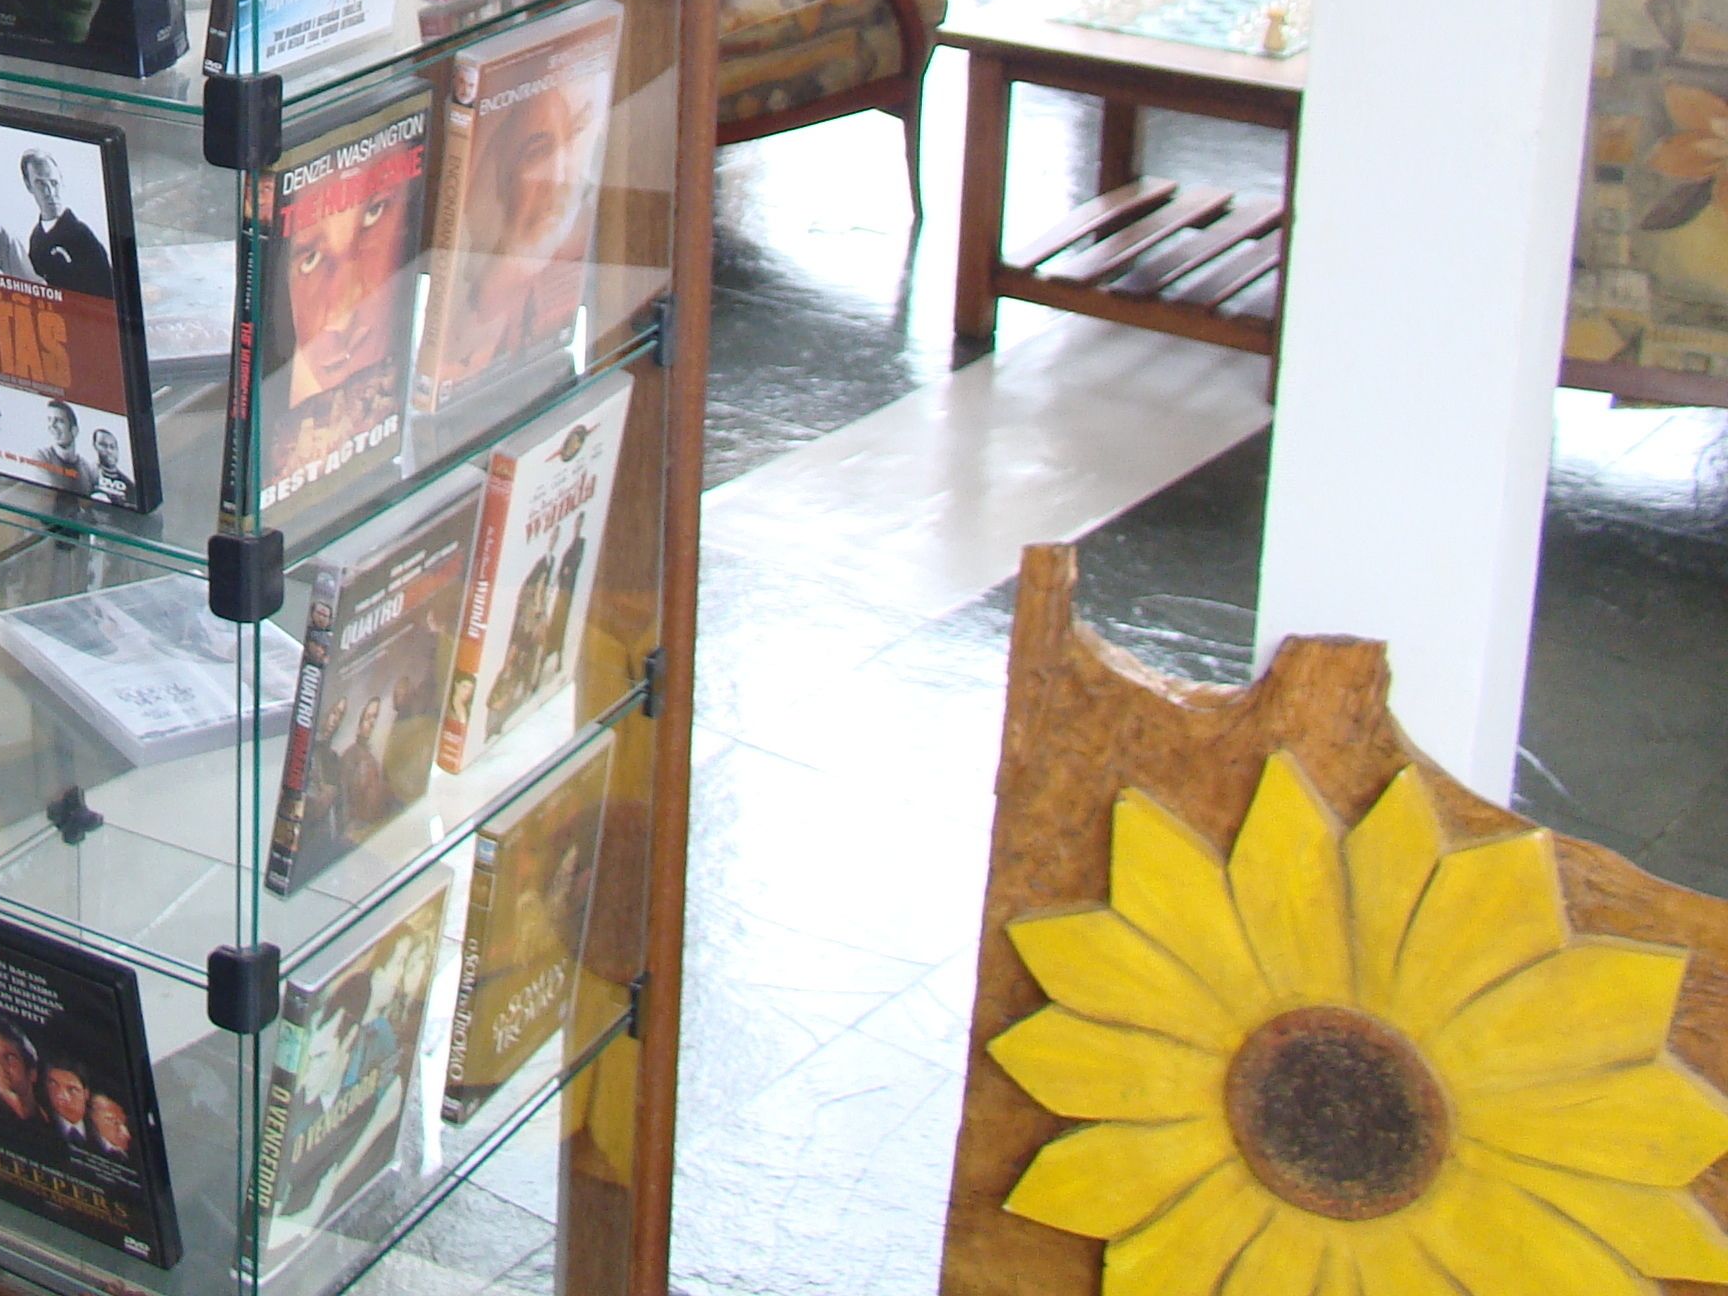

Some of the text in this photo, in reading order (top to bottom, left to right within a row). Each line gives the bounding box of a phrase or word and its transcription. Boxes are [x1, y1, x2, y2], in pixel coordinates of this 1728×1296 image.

[204, 60, 223, 72] DVD
[283, 113, 425, 196] DENZEL WASHINGTON
[281, 145, 425, 238] THE HURRICANE
[260, 414, 399, 511] BEST ACTOR
[98, 478, 126, 492] DVD
[339, 590, 406, 651] QUATRO
[467, 579, 489, 640] Wanda
[296, 663, 320, 729] QUATRO
[8, 964, 48, 986] BACON
[12, 975, 27, 988] DE
[29, 983, 59, 1000] NIRO
[463, 953, 481, 993] SOM
[9, 983, 65, 1012] HOFFMAN
[15, 995, 50, 1017] PATRIC
[21, 1007, 47, 1025] PITT
[292, 1068, 380, 1164] O VENCEDOR
[258, 1085, 292, 1209] O VENCEDOR
[124, 1236, 151, 1253] DVD
